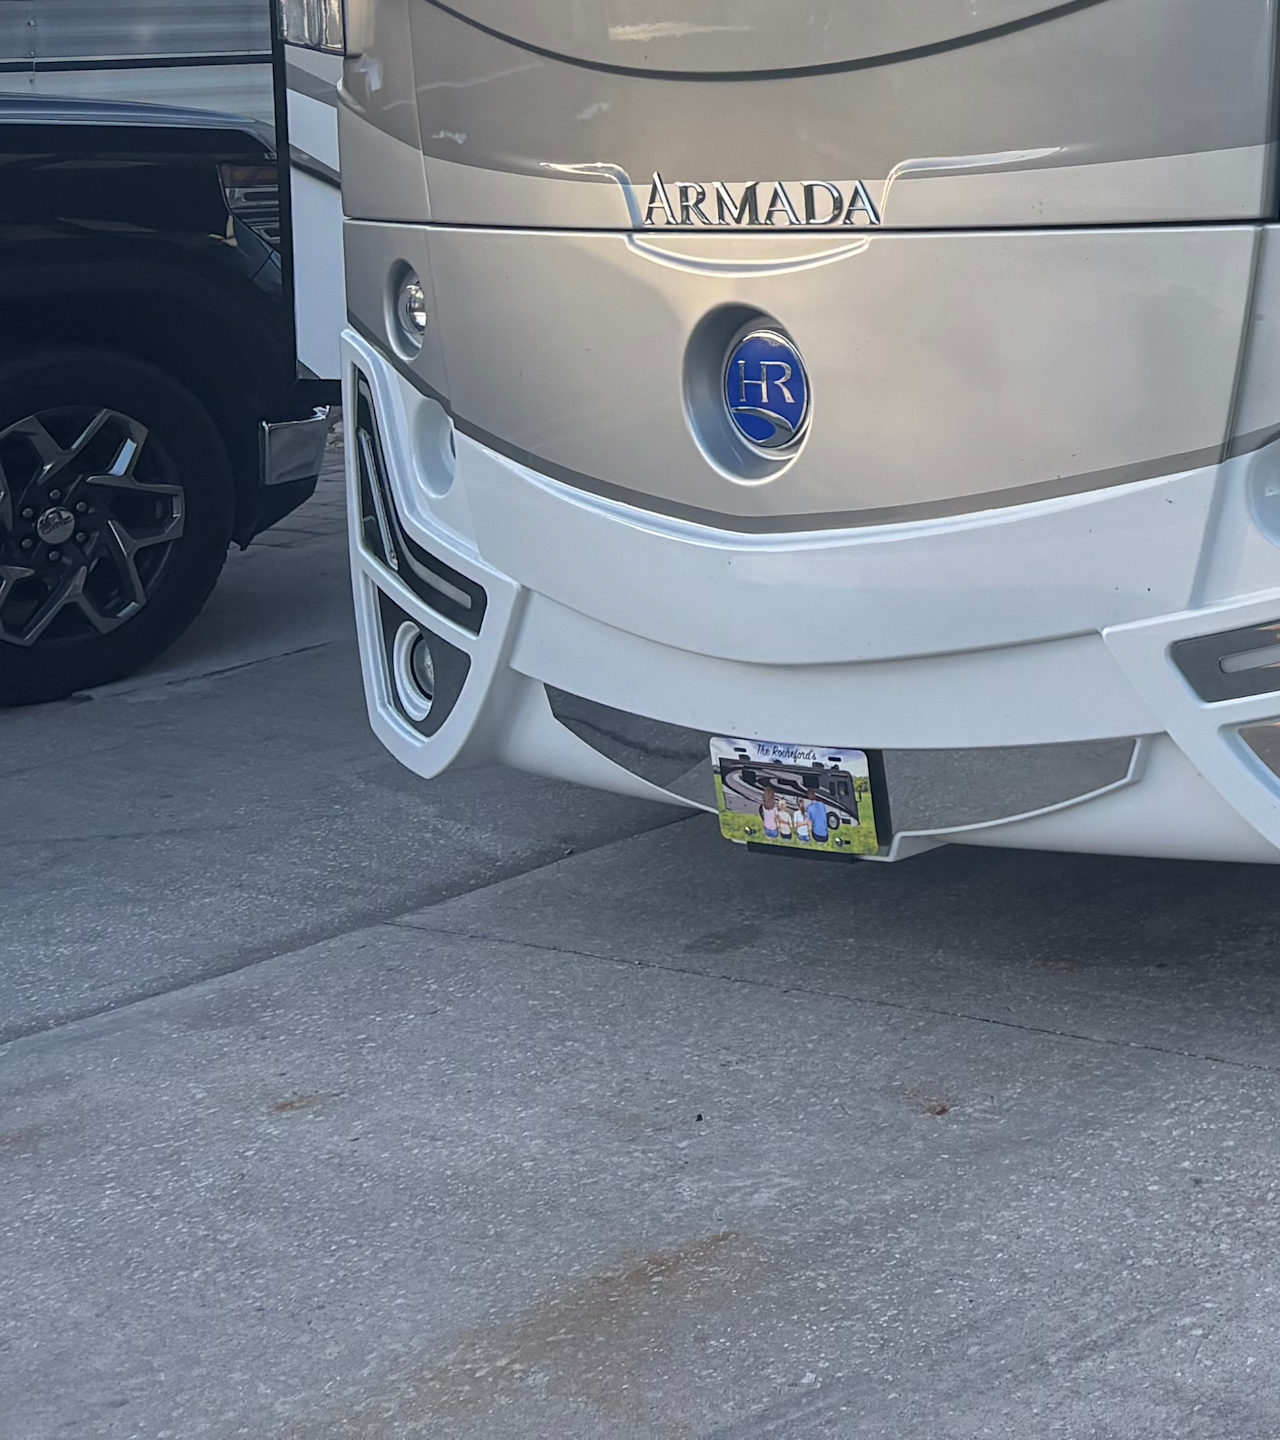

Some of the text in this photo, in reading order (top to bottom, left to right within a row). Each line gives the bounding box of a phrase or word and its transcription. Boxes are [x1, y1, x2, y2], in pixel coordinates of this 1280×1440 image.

[644, 170, 881, 226] ARMADA
[737, 360, 795, 403] HR
[757, 744, 770, 756] The
